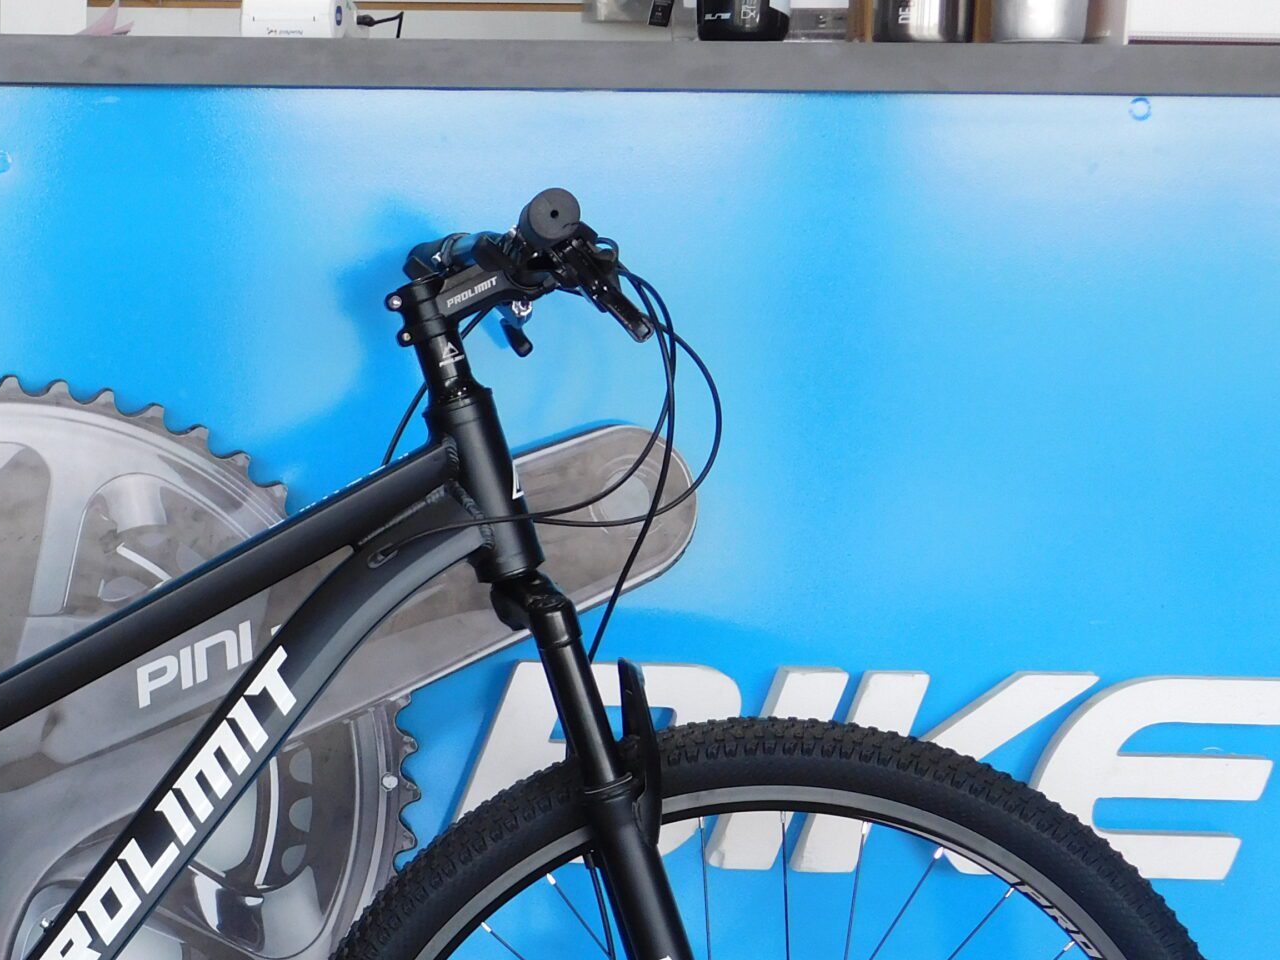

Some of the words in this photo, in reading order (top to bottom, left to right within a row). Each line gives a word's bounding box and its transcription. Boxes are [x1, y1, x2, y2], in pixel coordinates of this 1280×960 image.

[446, 275, 499, 309] PROLIMIT
[137, 620, 253, 709] PINI
[448, 659, 1280, 880] BIKE
